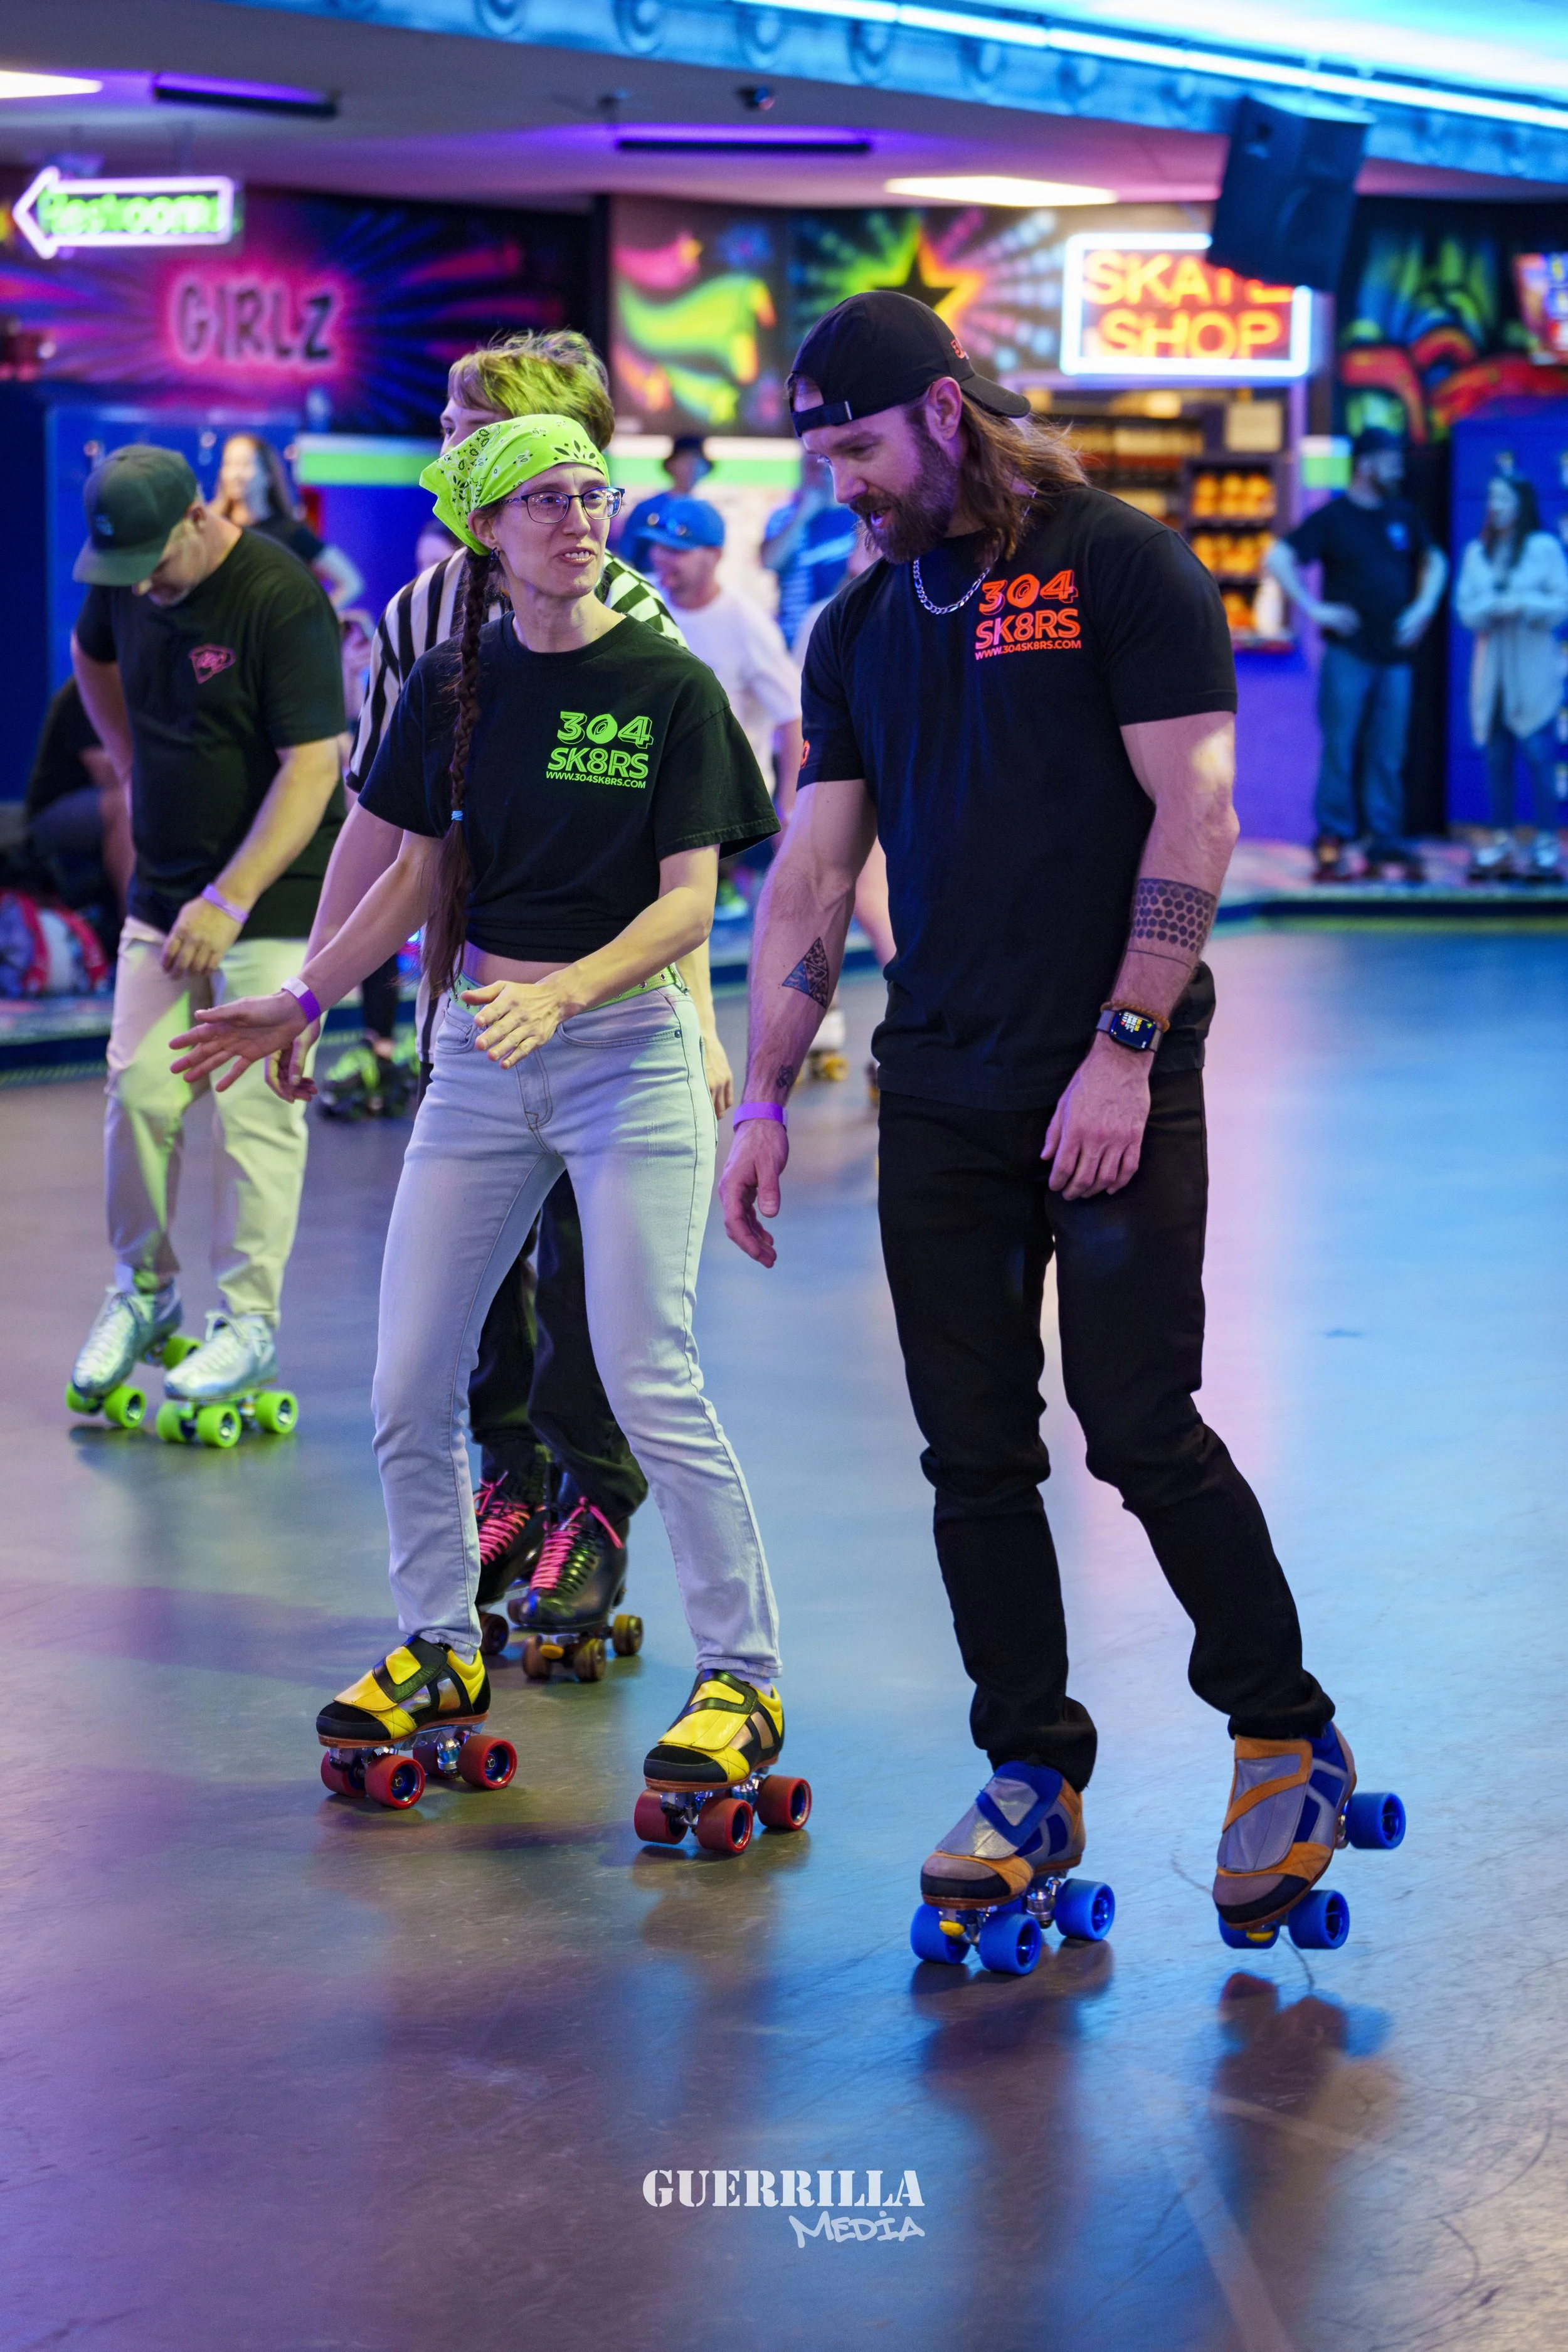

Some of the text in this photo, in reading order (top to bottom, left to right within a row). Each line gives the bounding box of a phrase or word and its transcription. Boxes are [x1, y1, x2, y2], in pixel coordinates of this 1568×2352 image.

[179, 283, 332, 360] GIRLZ
[1098, 309, 1283, 359] SHOP
[979, 569, 1078, 615] 304
[975, 608, 1081, 649] SK8RS
[975, 640, 1081, 660] WWW.304SK8RS.COM
[557, 711, 654, 749] 304
[546, 771, 646, 788] WWW.304SK8RS.COM
[547, 747, 649, 779] SK8RS
